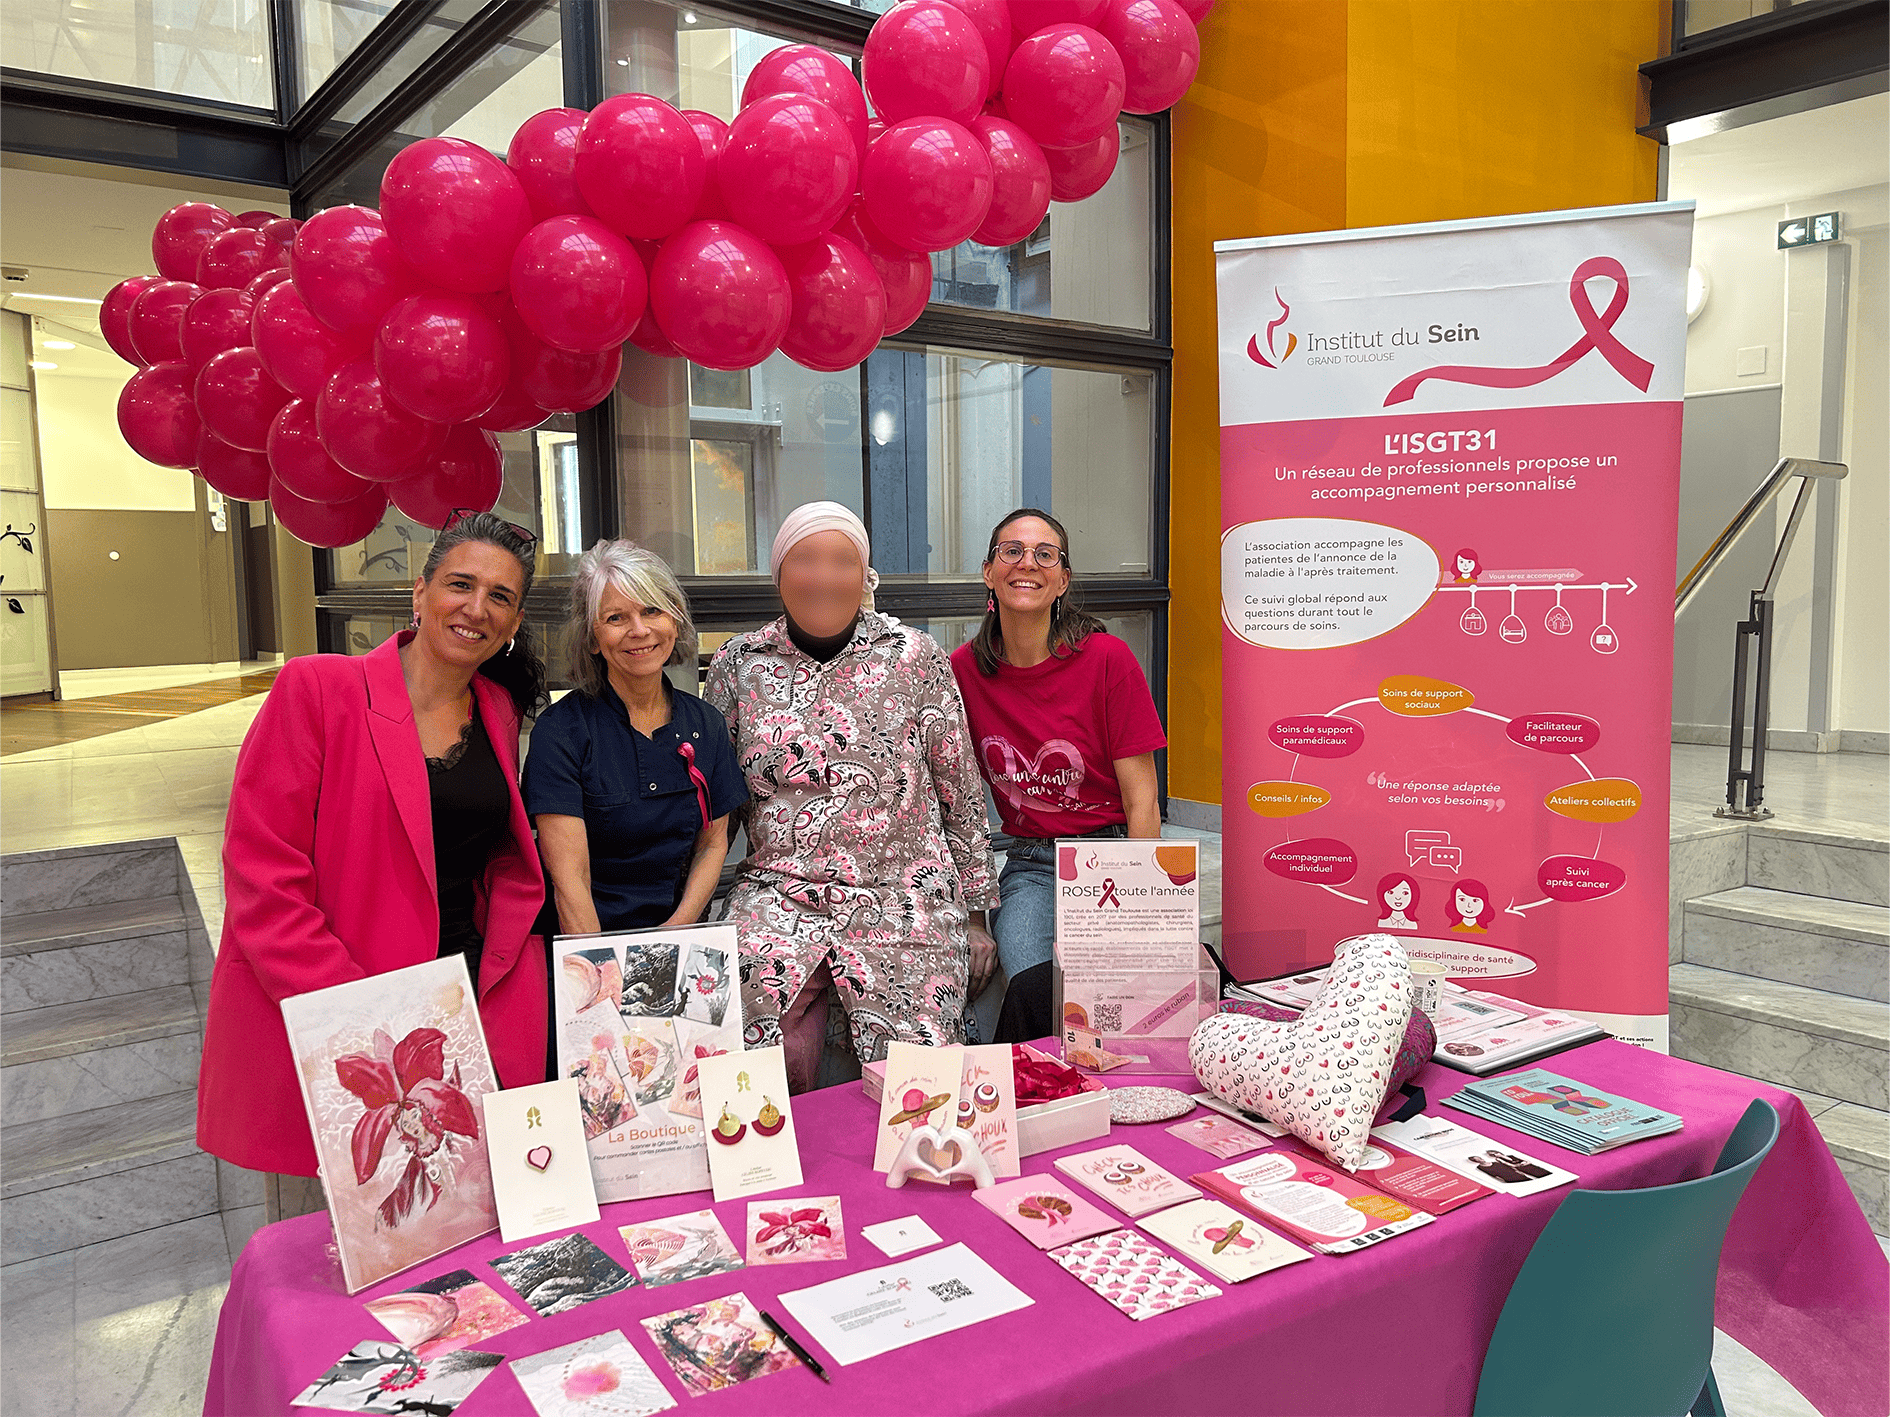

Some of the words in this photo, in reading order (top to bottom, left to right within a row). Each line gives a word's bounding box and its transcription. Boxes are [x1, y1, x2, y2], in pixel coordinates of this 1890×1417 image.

[1307, 331, 1384, 352] Institut
[1391, 327, 1420, 346] du
[1428, 323, 1480, 344] Sein
[1307, 355, 1342, 367] GRAND
[1344, 352, 1395, 364] TOULOUSE
[1275, 467, 1297, 481] Un
[1302, 464, 1356, 480] réseau
[1361, 462, 1382, 477] de
[1387, 456, 1511, 480] professionnels
[1516, 456, 1590, 475] propose
[1596, 454, 1618, 467] un
[1311, 481, 1460, 502] accompagnement
[1466, 475, 1577, 498] personnalisé
[1314, 539, 1385, 550] accompagne
[1387, 537, 1404, 547] les
[1244, 555, 1294, 567] patientes
[1296, 553, 1311, 563] de
[1369, 551, 1384, 561] de
[1387, 551, 1397, 561] la
[1244, 567, 1285, 578] maladie
[1288, 567, 1295, 577] à
[1297, 566, 1334, 579] l'après
[1337, 566, 1399, 576] traitement.
[1526, 571, 1575, 580] accompagnée
[1244, 595, 1259, 604] Ce
[1261, 595, 1285, 604] suivi
[1288, 593, 1322, 606] global
[1324, 593, 1365, 605] répond
[1367, 594, 1388, 602] aux
[1244, 608, 1295, 619] questions
[1297, 607, 1334, 617] durant
[1337, 607, 1360, 616] tout
[1363, 606, 1373, 616] le
[1244, 622, 1290, 633] parcours
[1292, 620, 1307, 630] de
[1309, 620, 1340, 630] soins.
[1382, 688, 1408, 697] Soins
[1410, 688, 1423, 698] de
[1425, 689, 1463, 700] support
[1404, 700, 1440, 709] sociaux
[1276, 725, 1301, 734] Soins
[1302, 725, 1315, 734] de
[1317, 725, 1353, 735] support
[1526, 721, 1582, 731] Facilitateur
[1282, 736, 1347, 747] paramédicaux
[1524, 733, 1537, 742] de
[1540, 734, 1584, 744] parcours
[1402, 780, 1450, 792] réponse
[1452, 781, 1501, 794] adaptée
[1254, 793, 1292, 803] Conseils
[1293, 795, 1299, 803] /
[1300, 794, 1323, 803] infos
[1388, 794, 1418, 804] selon
[1421, 796, 1441, 804] vos
[1549, 796, 1589, 806] Ateliers
[1591, 797, 1637, 807] collectifs
[1269, 852, 1353, 864] Accompagnement
[1289, 864, 1333, 873] individuel
[1566, 866, 1590, 876] Suivi
[1546, 878, 1574, 888] après
[1576, 880, 1610, 889] cancer
[1062, 885, 1101, 897] ROSE
[1114, 887, 1148, 896] toute
[1150, 885, 1195, 896] l'année
[1472, 953, 1485, 962] de
[1487, 955, 1514, 964] santé
[1450, 964, 1488, 974] support
[1147, 1012, 1165, 1026] euros
[1165, 1005, 1171, 1013] le
[1170, 992, 1190, 1008] ruban
[1067, 1031, 1076, 1043] 10
[608, 1131, 625, 1143] La
[630, 1124, 696, 1141] Boutique
